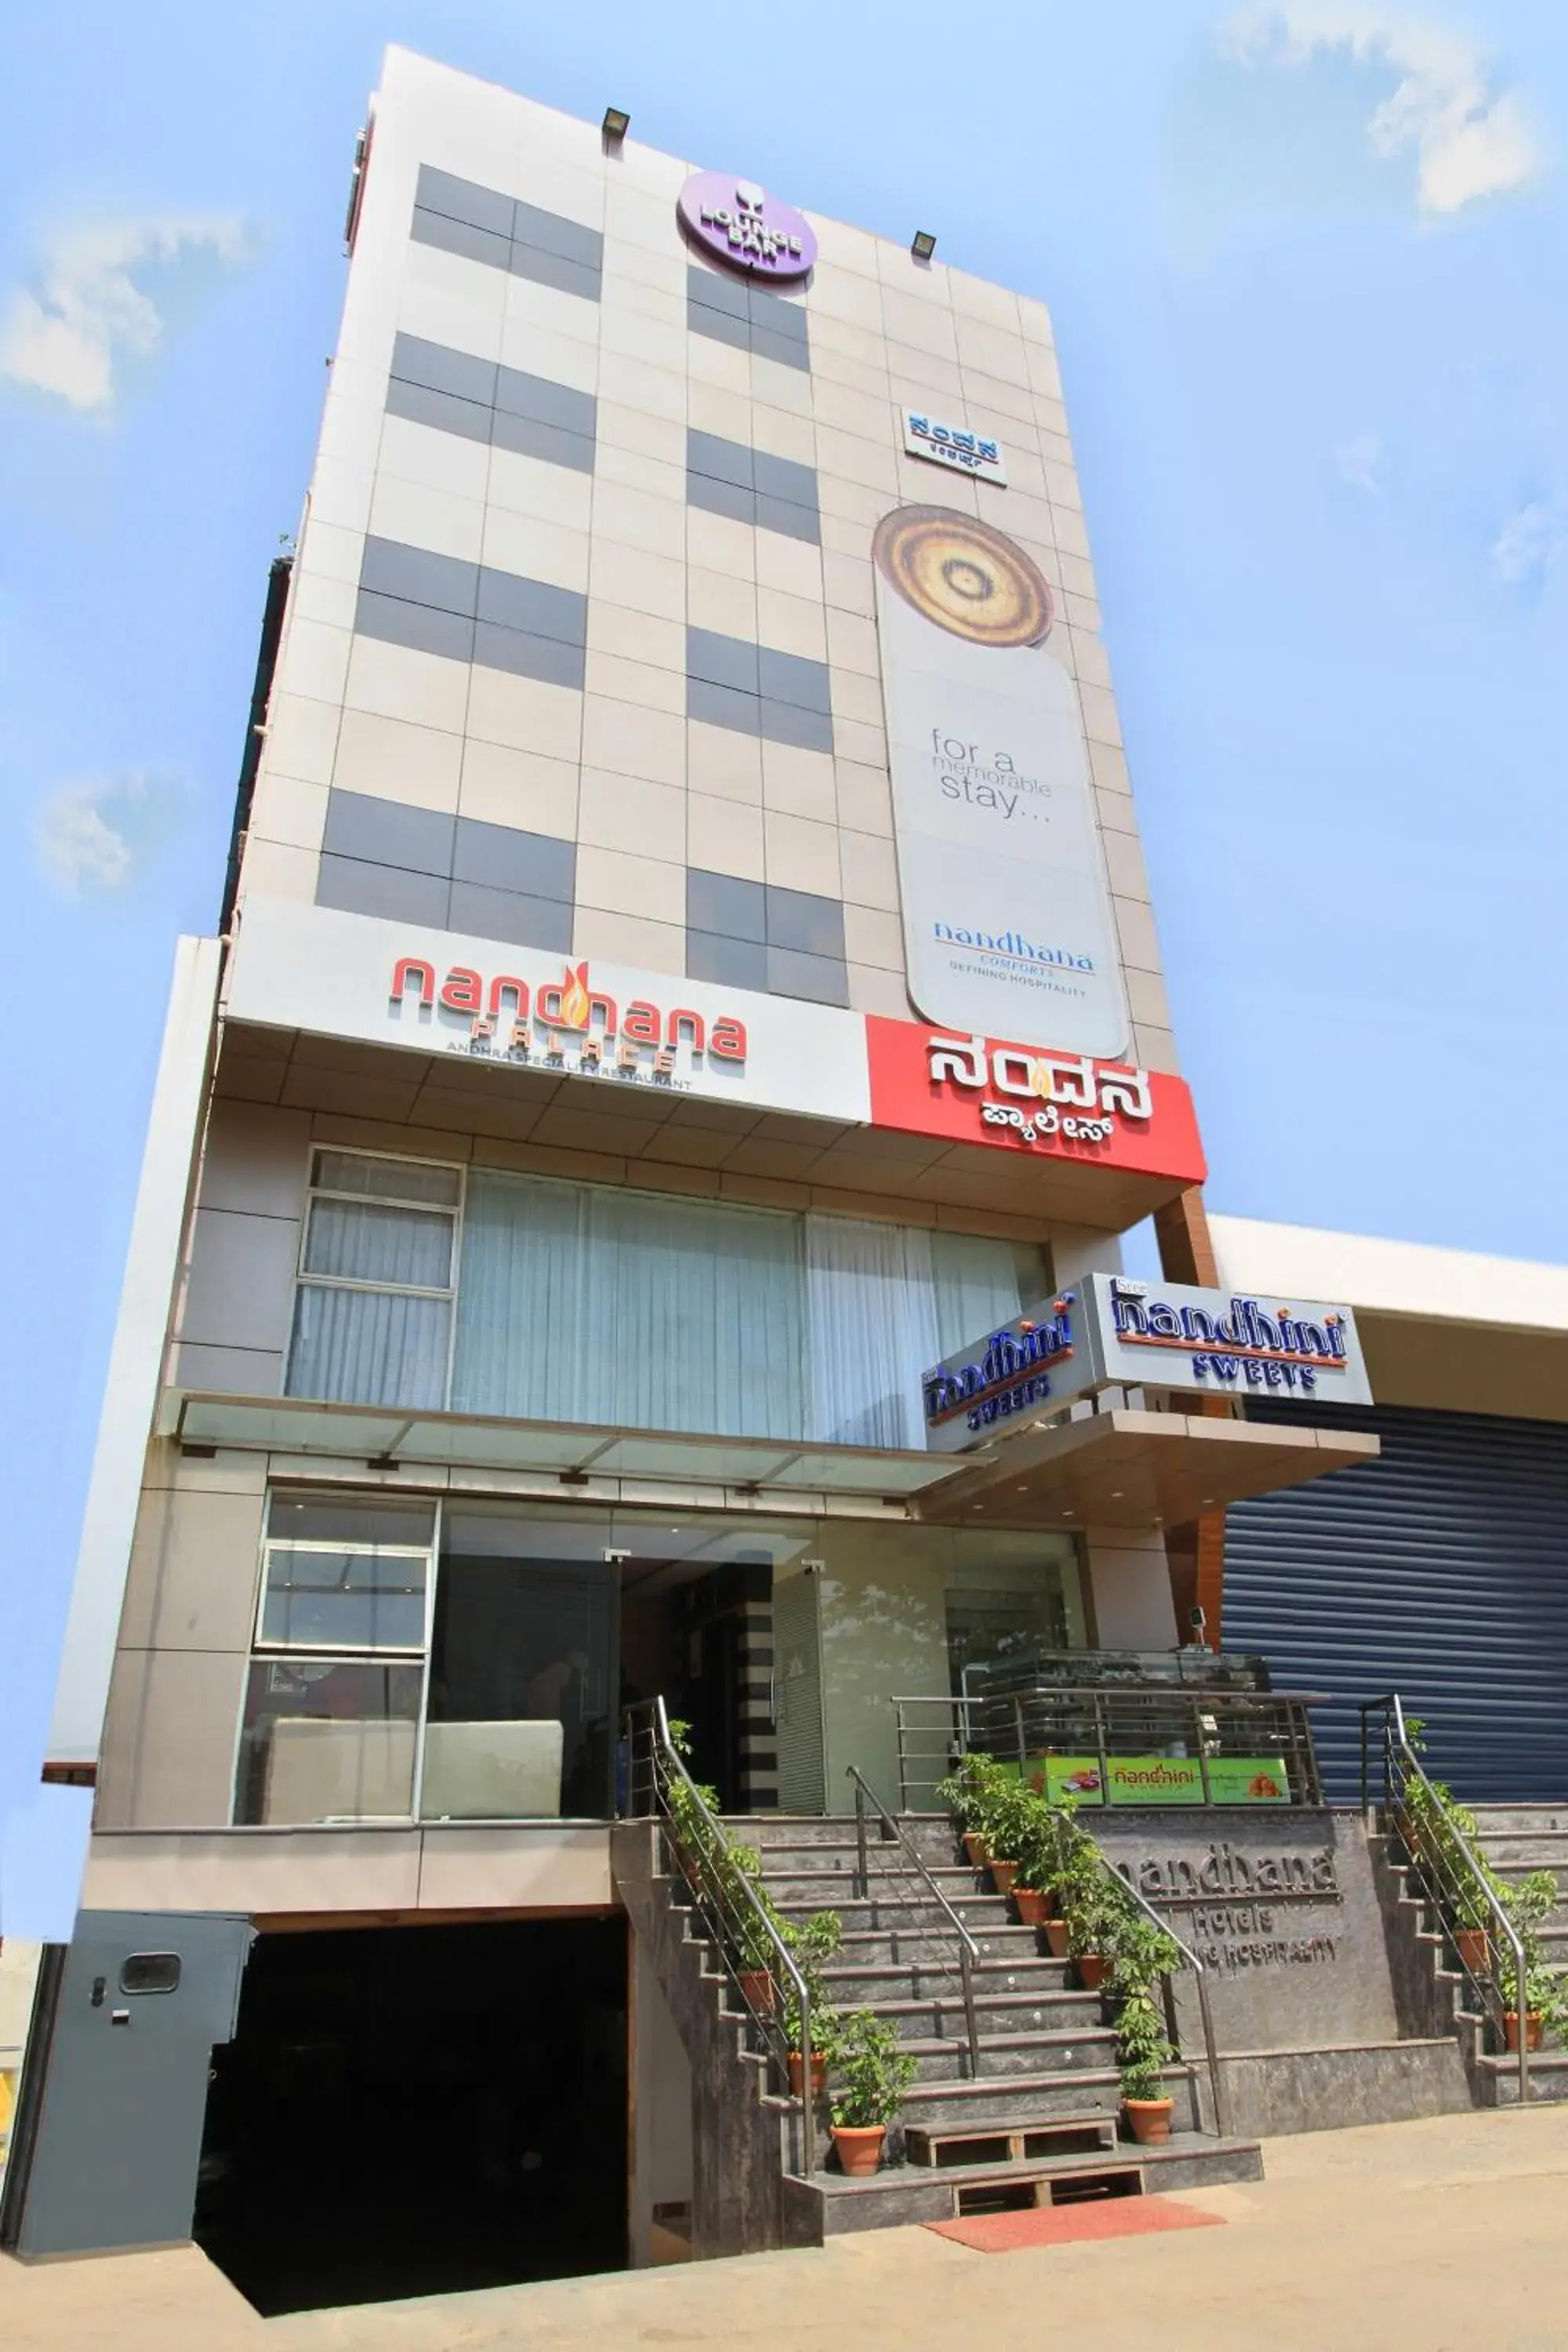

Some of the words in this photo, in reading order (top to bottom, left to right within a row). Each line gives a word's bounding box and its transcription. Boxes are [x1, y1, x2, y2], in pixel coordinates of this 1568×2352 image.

[699, 204, 803, 256] LOUNGE
[727, 226, 779, 260] BAR
[931, 728, 978, 764] for
[994, 751, 1016, 775] a
[931, 755, 1052, 798] memorable
[934, 922, 1094, 971] nandhana
[980, 954, 1054, 978] COMFORTS
[949, 959, 1007, 982] DEFINING
[1010, 973, 1086, 998] HOSPITALITY
[390, 956, 748, 1061] nandhana
[471, 1018, 676, 1073] PALACE
[928, 1034, 1153, 1120] ನಂದನ
[1112, 1298, 1348, 1358] nandhini
[1192, 1352, 1318, 1388] SWEETS
